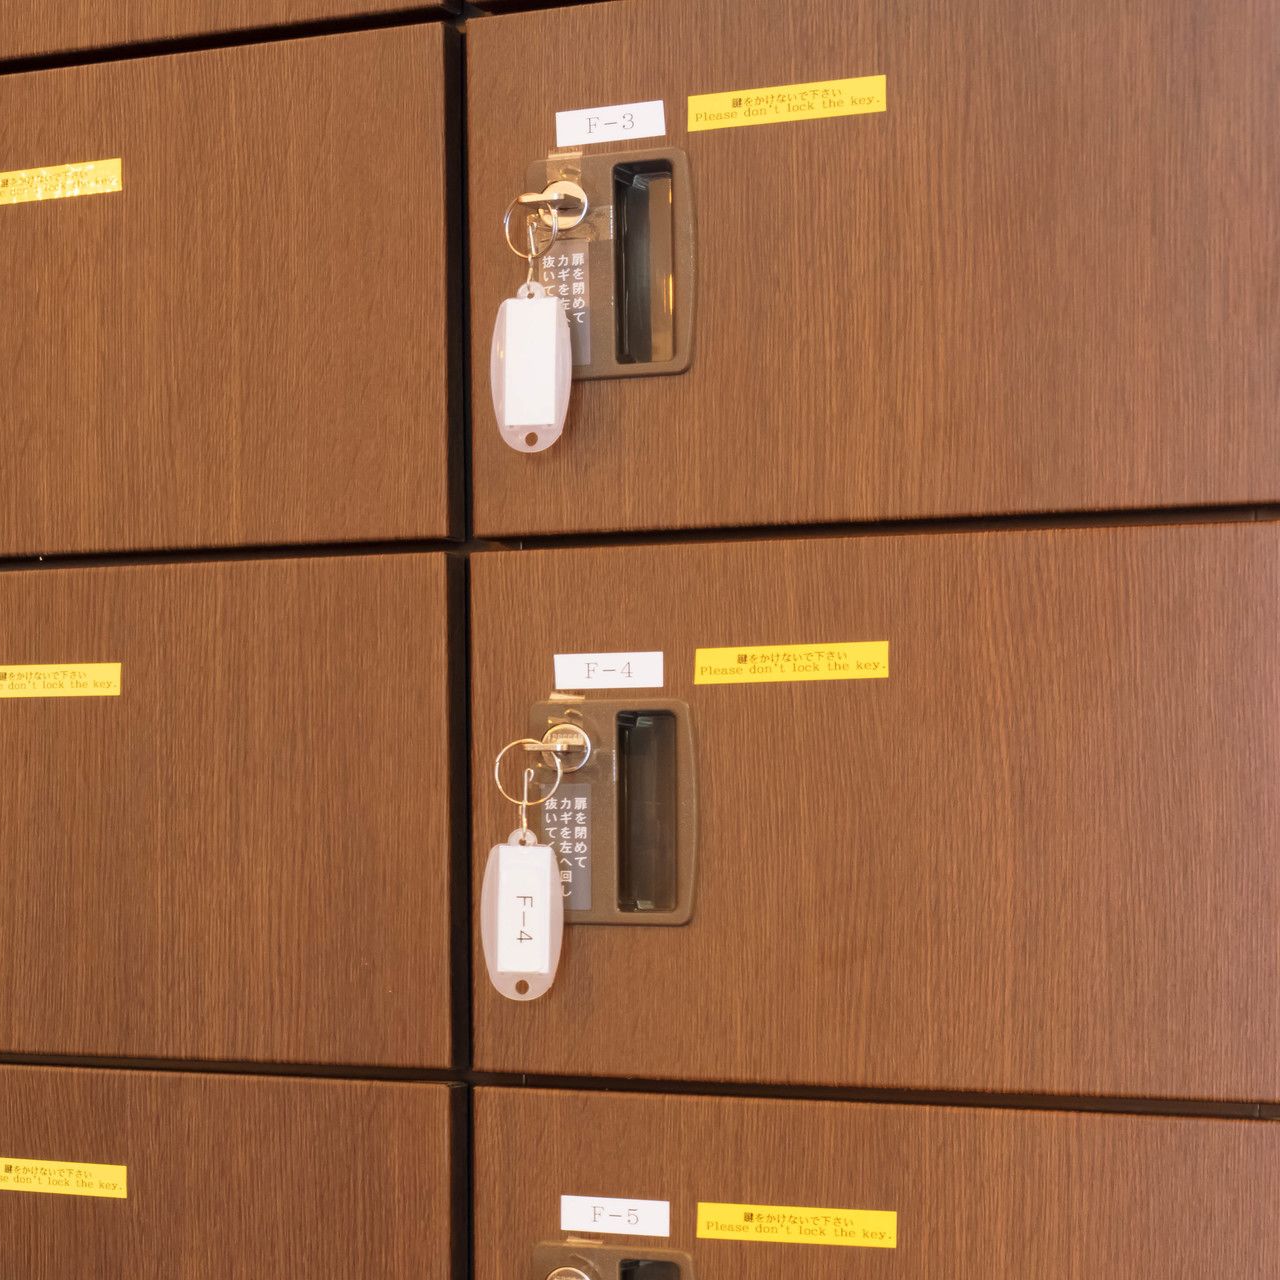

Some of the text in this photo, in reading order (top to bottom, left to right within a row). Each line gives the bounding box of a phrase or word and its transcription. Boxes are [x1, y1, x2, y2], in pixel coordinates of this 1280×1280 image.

[732, 87, 842, 109] 鍵をかけないで下さい
[694, 94, 881, 123] Please don't lock the key.
[587, 113, 635, 134] F-3
[571, 252, 586, 324] 扉を閉めて
[737, 650, 847, 665] 鍵をかけないで下さい
[585, 661, 633, 679] F-4
[700, 660, 886, 676] Please don't lock the key.
[8, 681, 38, 689] don't
[43, 680, 67, 689] lock
[72, 680, 91, 688] the
[95, 679, 118, 689] key.
[574, 797, 587, 869] 扉を閉めて
[559, 797, 573, 897] カギを左へ回し
[516, 895, 533, 943] F-4
[14, 1174, 44, 1184] don't
[48, 1176, 73, 1186] lock
[77, 1178, 97, 1188] the
[101, 1180, 124, 1191] key.
[591, 1205, 639, 1225] F-5
[743, 1211, 854, 1227] 鍵をかけないで下さい
[706, 1220, 894, 1240] Please don't lock the key.
